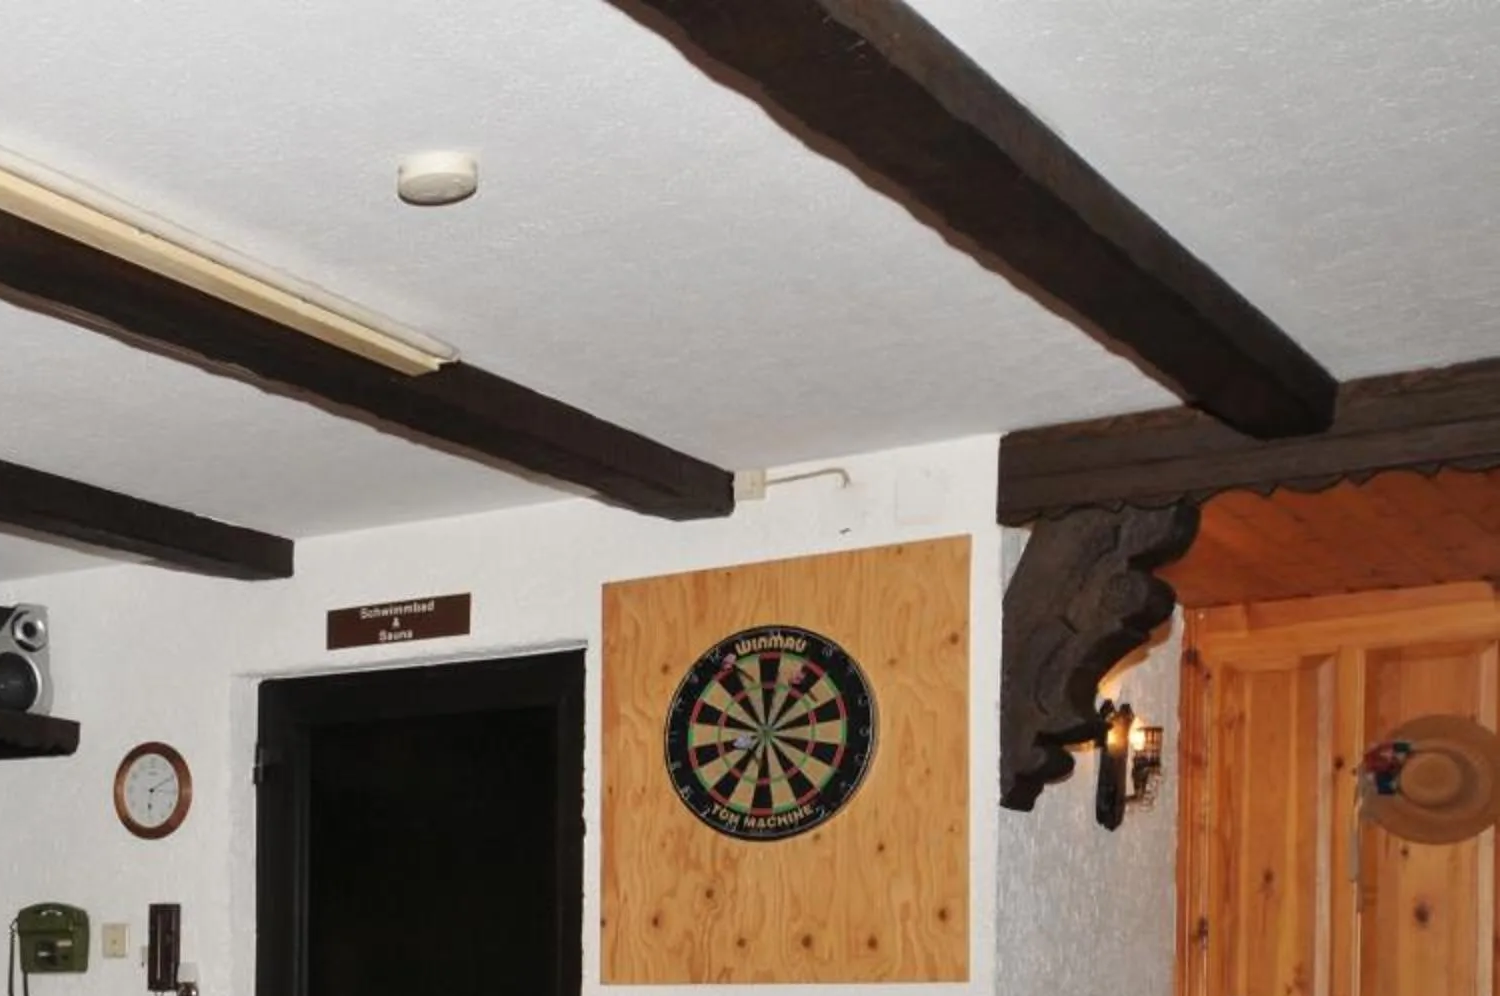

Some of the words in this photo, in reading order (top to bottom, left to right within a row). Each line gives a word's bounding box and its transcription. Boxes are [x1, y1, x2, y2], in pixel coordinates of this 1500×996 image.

[360, 599, 435, 619] Schwimmbad
[379, 629, 414, 643] Sauna
[742, 804, 814, 829] MACHINE
